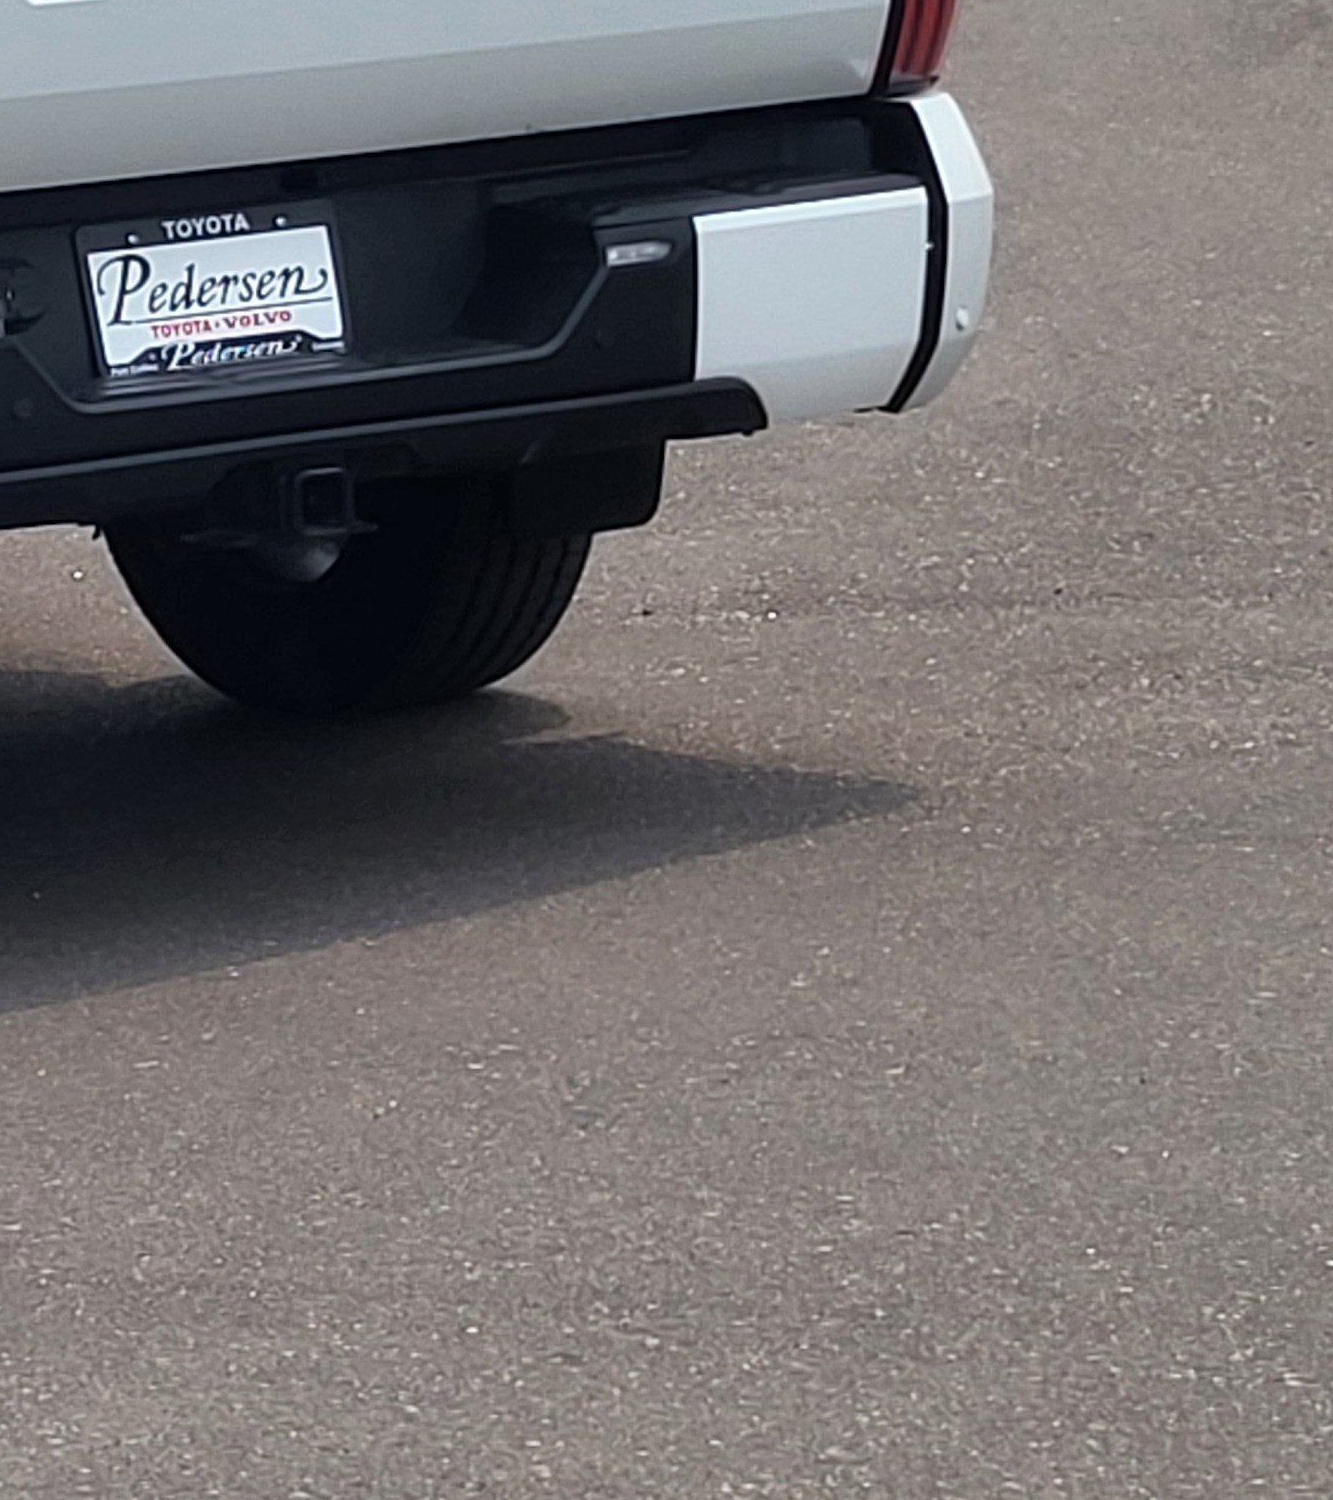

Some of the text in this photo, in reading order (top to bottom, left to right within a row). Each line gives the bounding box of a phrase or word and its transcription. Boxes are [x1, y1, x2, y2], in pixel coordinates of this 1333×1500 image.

[161, 213, 250, 240] TOYOTA
[97, 254, 329, 326] Pedersen
[150, 311, 292, 338] TOYOTA VOLVO
[161, 335, 302, 371] Pedersen
